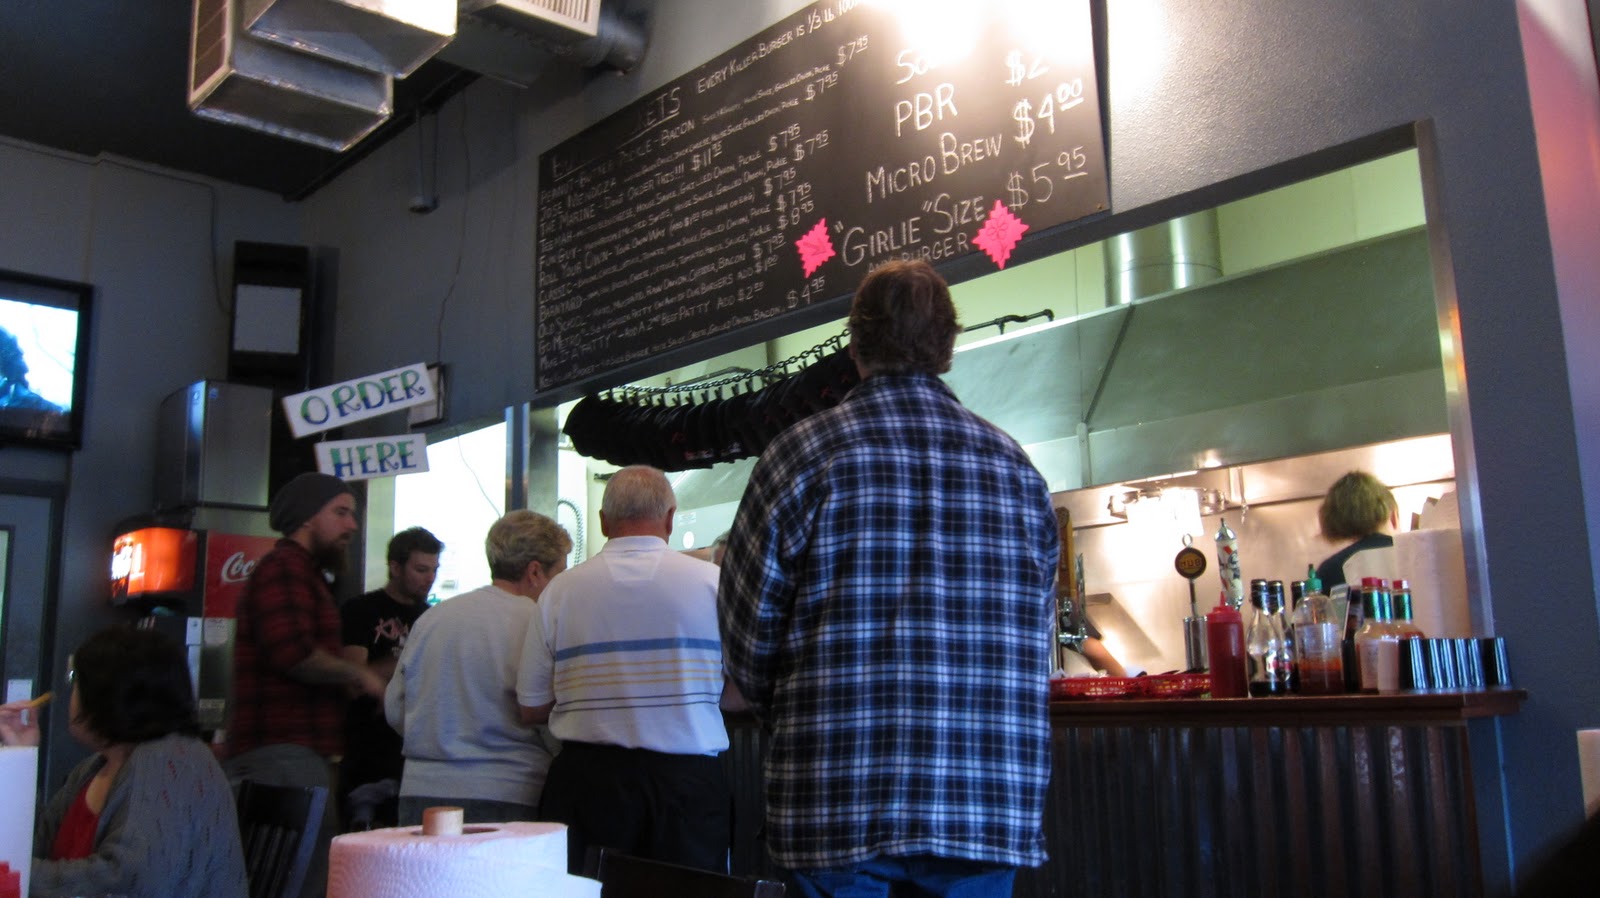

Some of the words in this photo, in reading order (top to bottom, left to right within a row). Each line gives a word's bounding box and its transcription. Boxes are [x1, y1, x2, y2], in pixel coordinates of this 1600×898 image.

[696, 63, 727, 95] EVERY
[729, 46, 756, 77] KILLER
[758, 25, 792, 59] BURGER
[795, 22, 804, 38] IS
[808, 5, 821, 34] 1/3
[894, 82, 958, 137] PBR
[866, 156, 937, 203] MICRO
[939, 131, 1003, 175] BREW
[933, 192, 986, 234] SIZE
[678, 296, 710, 321] PATTY
[300, 369, 427, 425] ORDER
[330, 440, 417, 478] HERE
